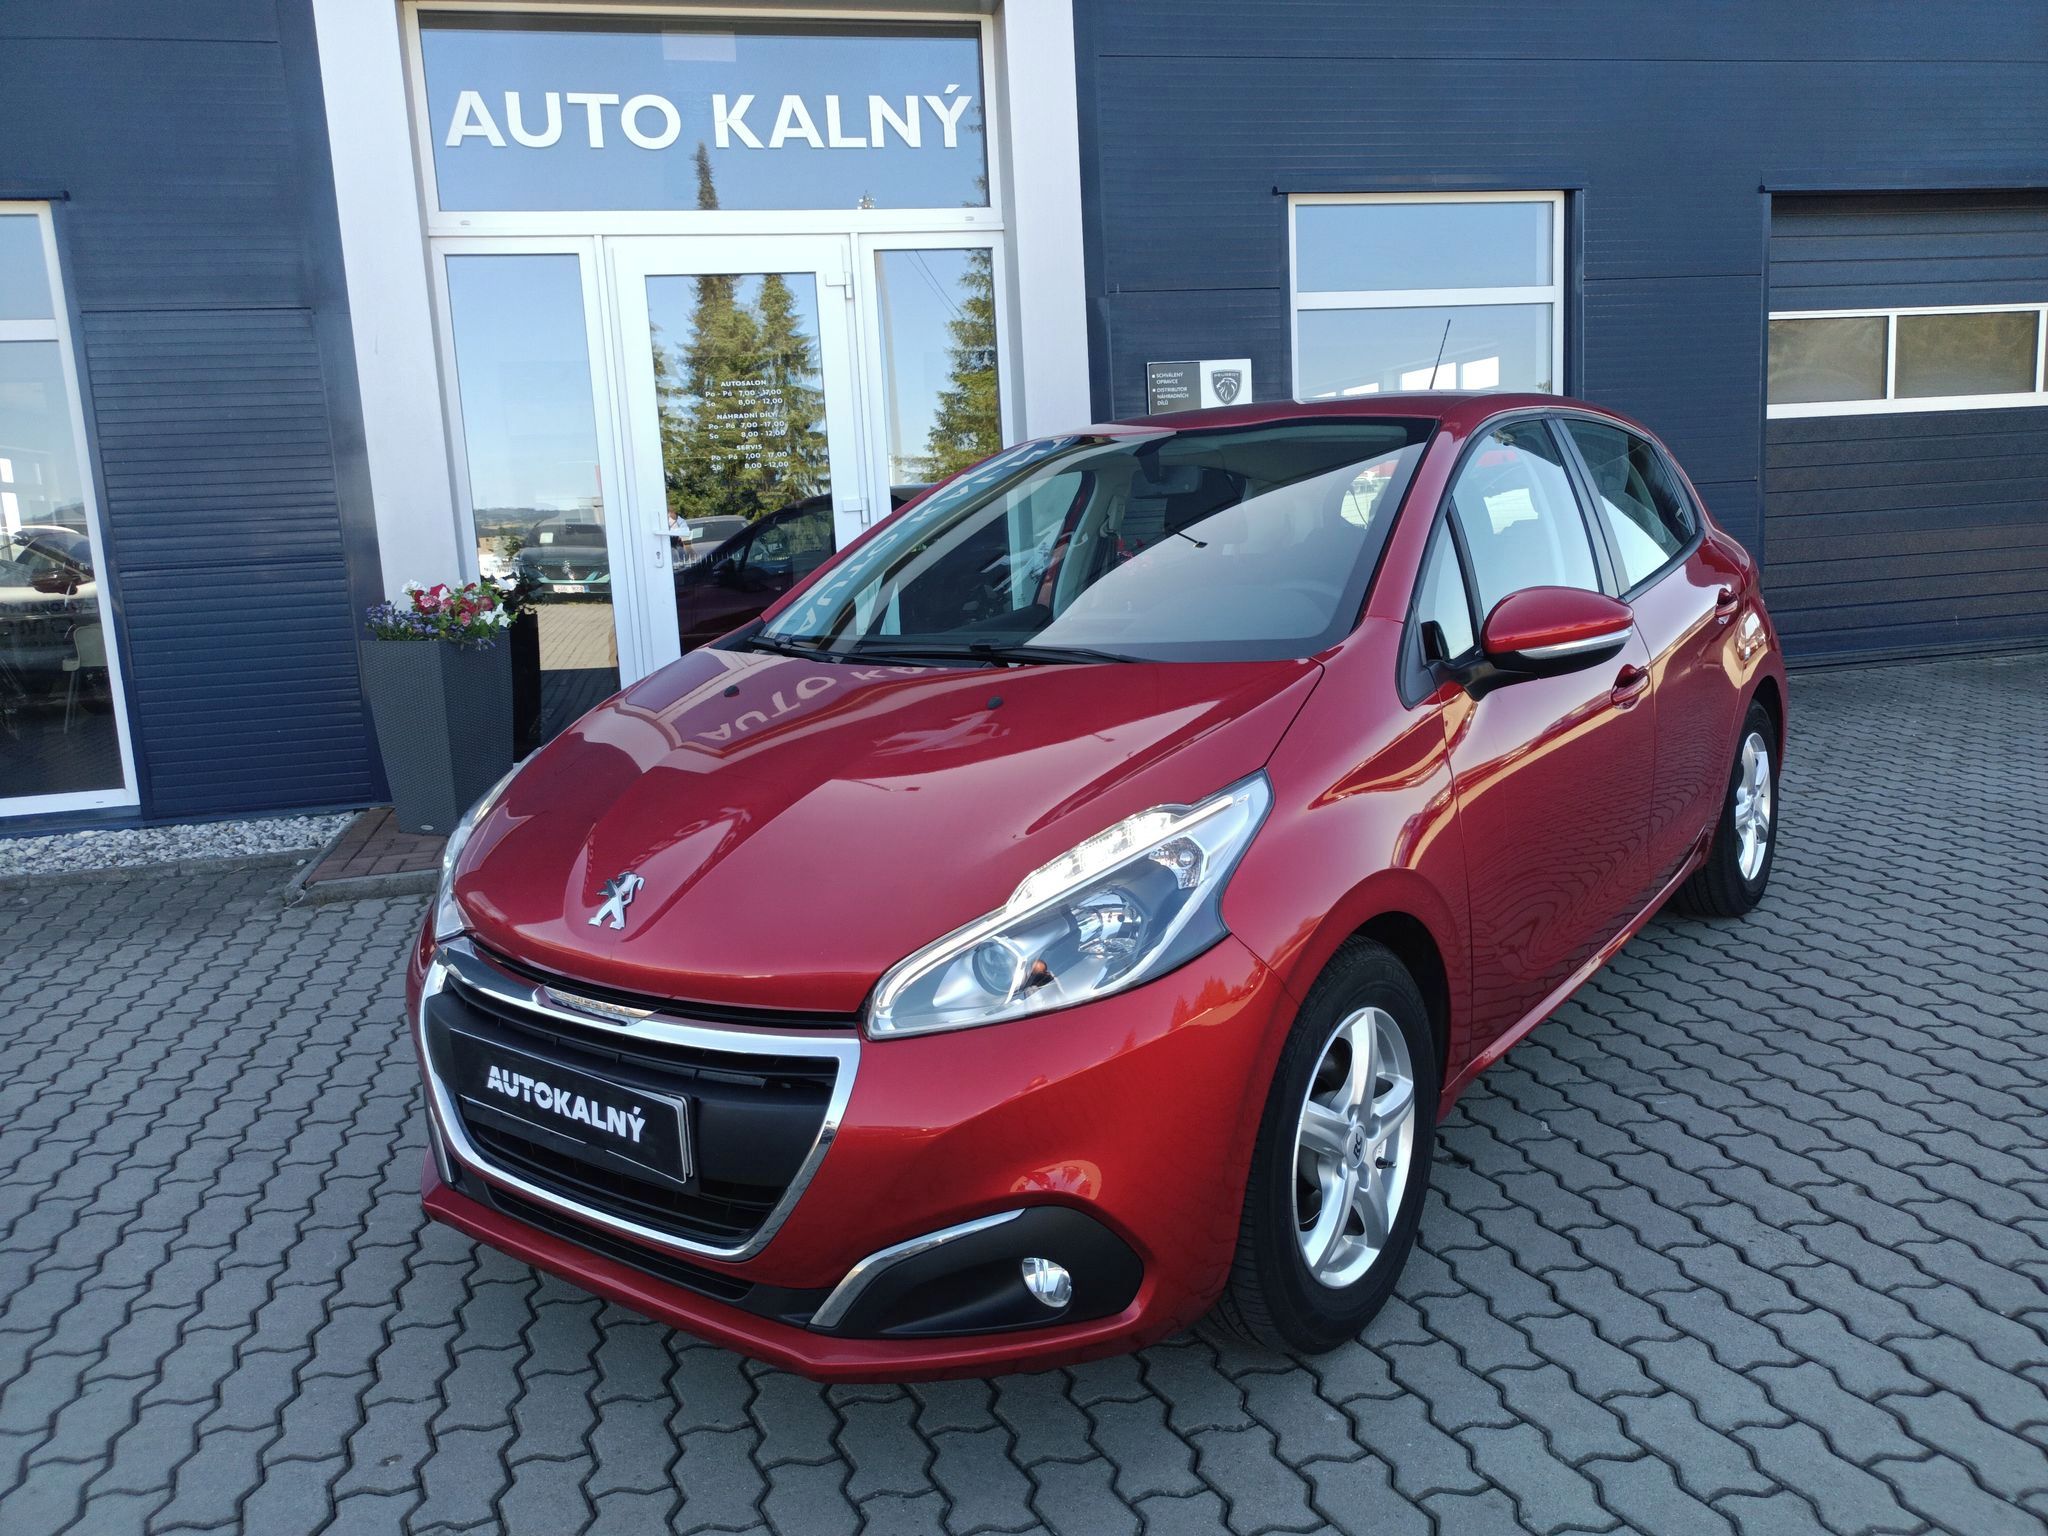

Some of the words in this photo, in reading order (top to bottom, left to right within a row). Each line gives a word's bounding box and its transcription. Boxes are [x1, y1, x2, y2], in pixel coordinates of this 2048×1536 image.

[446, 91, 681, 149] AUTO
[712, 84, 972, 149] KALNÝ
[487, 1065, 646, 1143] AUTOKALNÝ
